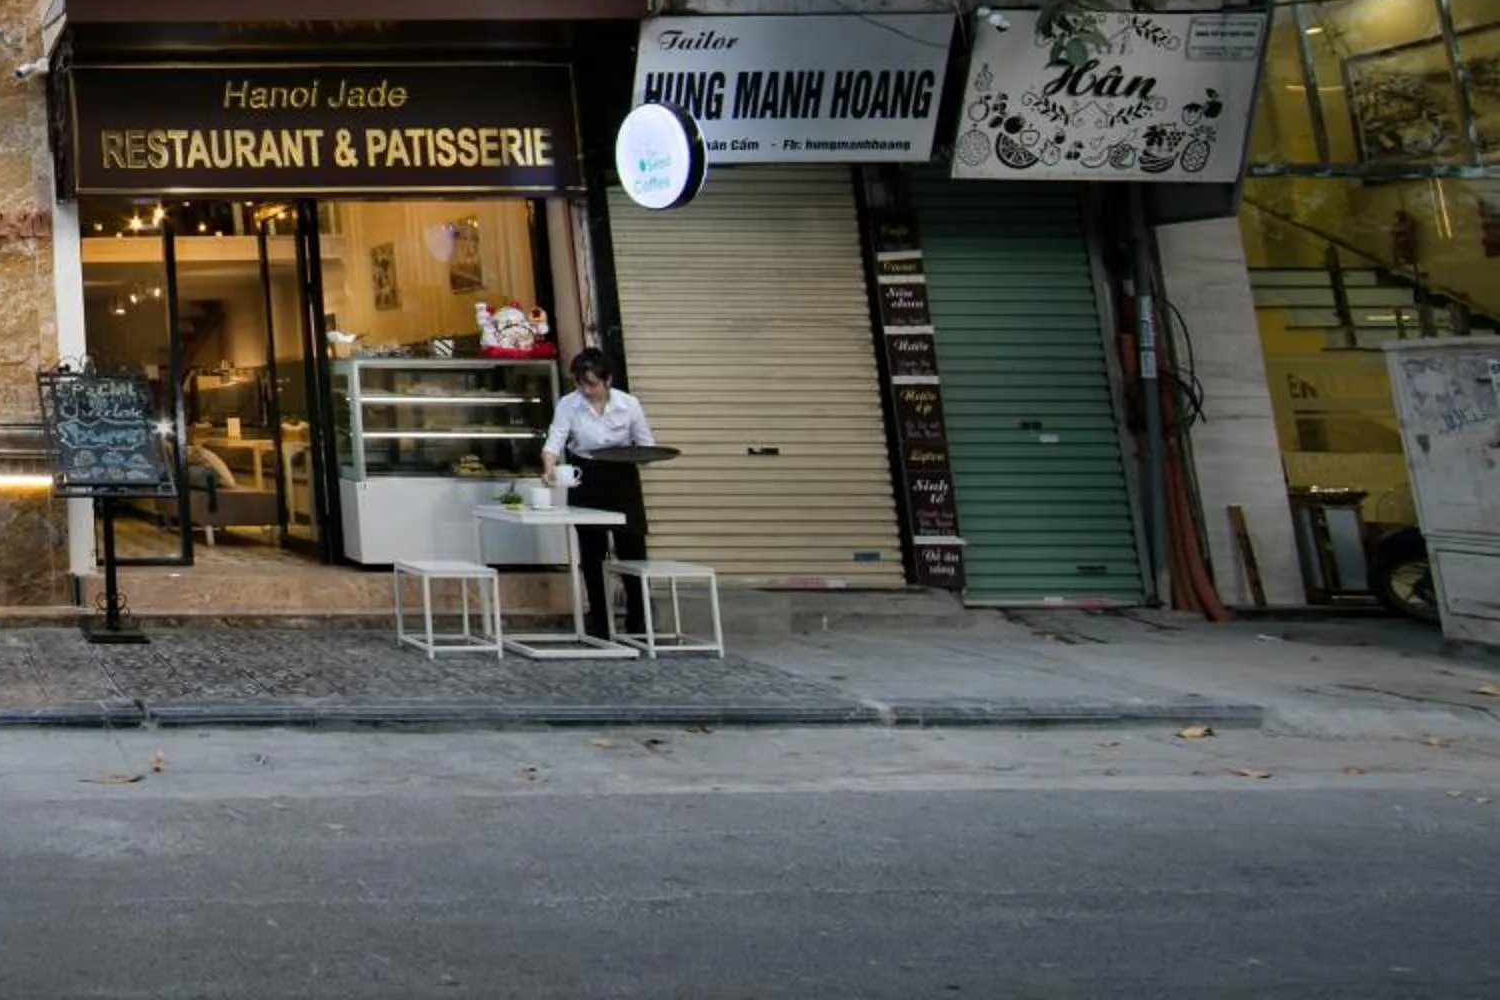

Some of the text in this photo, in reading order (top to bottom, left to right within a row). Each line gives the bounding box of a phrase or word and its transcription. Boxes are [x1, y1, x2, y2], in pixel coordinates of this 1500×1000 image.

[658, 28, 740, 51] Tailor
[223, 78, 411, 109] Hanoi Jade
[731, 70, 825, 119] MANH
[830, 69, 935, 119] HOANG
[101, 128, 555, 169] RESTAURANT & PATISSERIE
